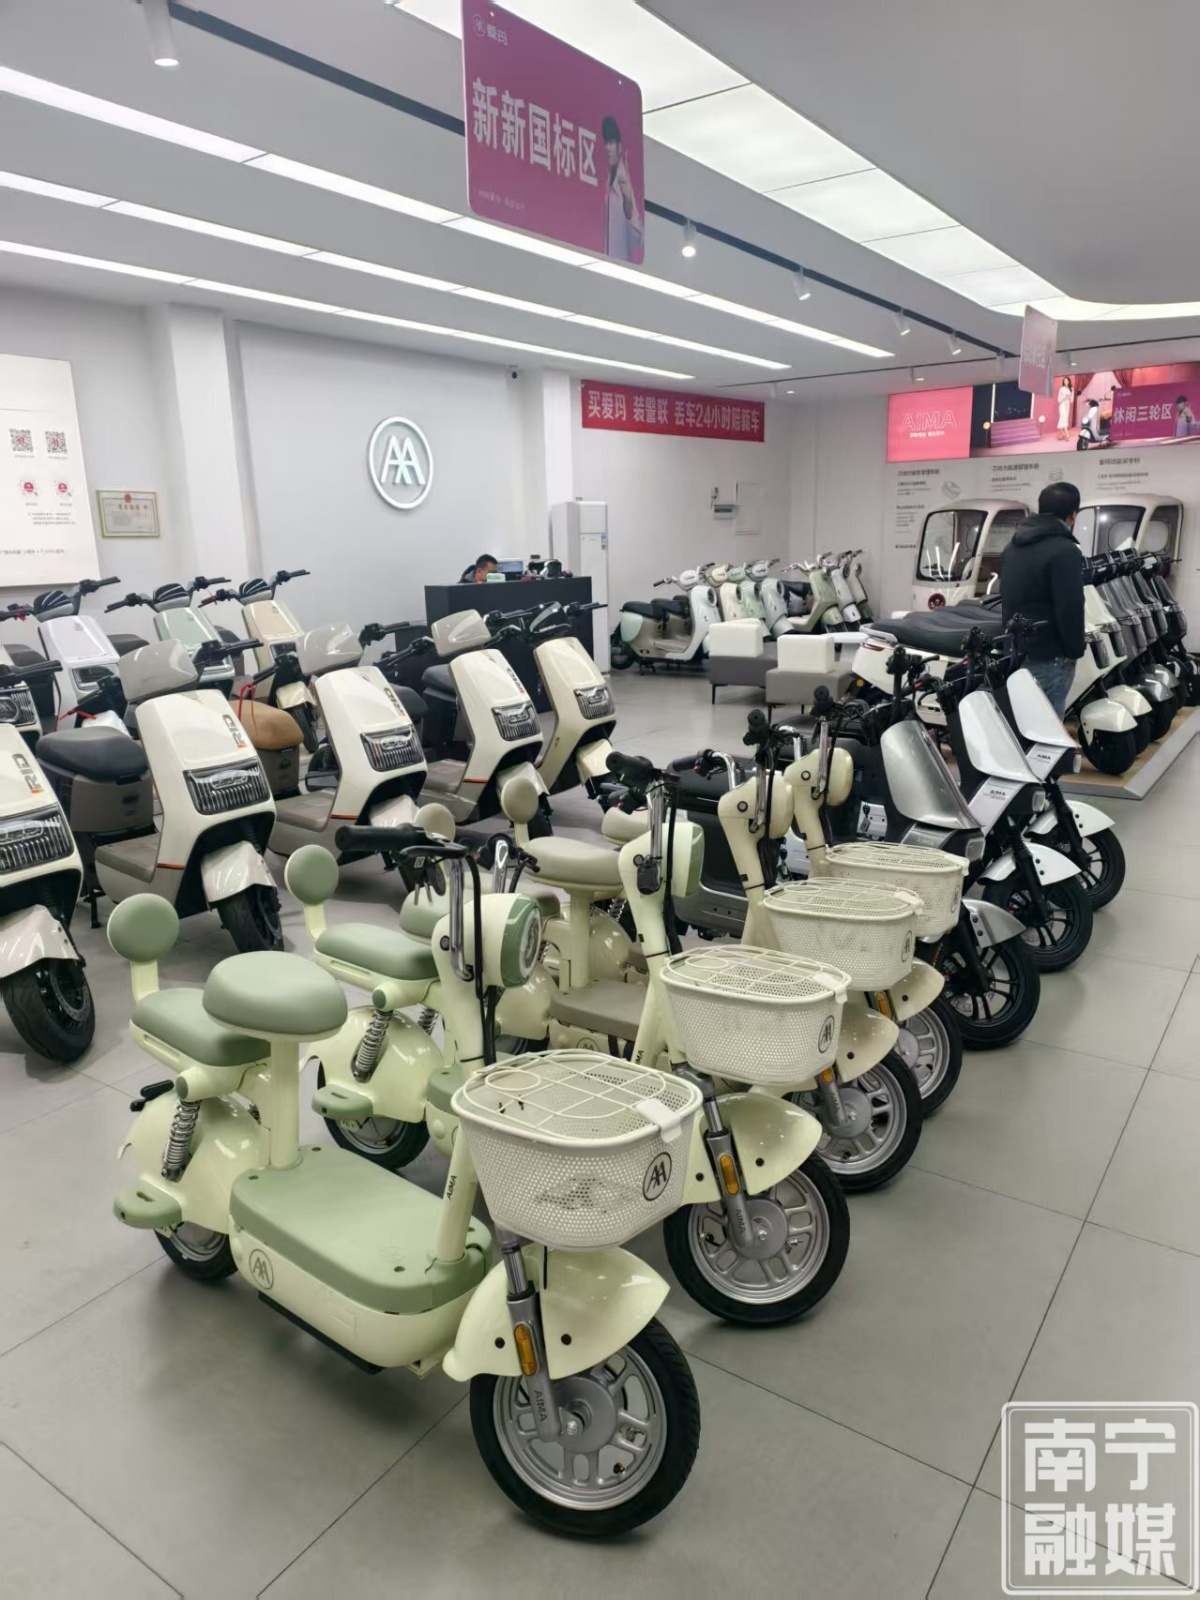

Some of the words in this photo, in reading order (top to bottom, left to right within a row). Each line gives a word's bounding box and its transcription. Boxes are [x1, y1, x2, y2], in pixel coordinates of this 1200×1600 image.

[473, 77, 598, 187] 新新国标区
[588, 390, 627, 421] 买爱玛
[1113, 403, 1173, 424] 休闲三轮区
[900, 409, 959, 432] AIMA
[446, 1175, 457, 1200] AIMA
[735, 1209, 746, 1233] AIMA
[533, 1390, 547, 1422] AIMA
